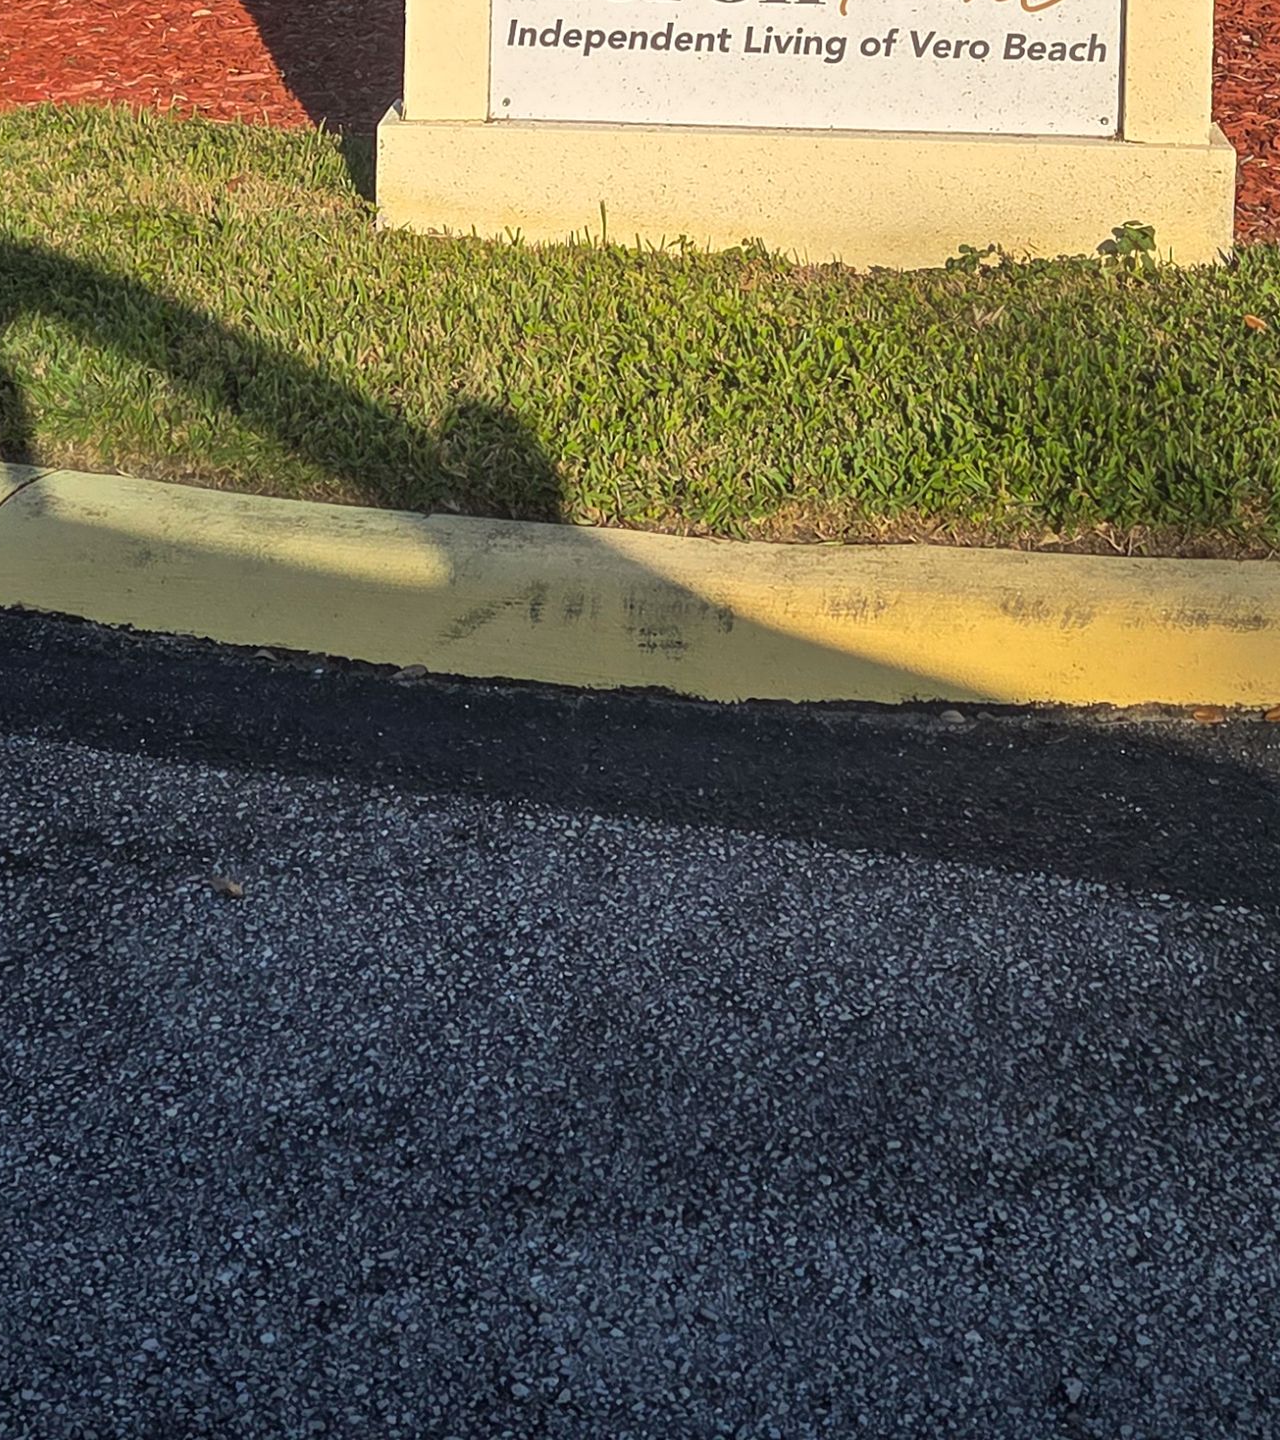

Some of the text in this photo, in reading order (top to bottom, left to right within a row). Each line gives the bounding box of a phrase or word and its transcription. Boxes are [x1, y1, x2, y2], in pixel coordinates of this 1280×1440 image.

[507, 19, 1108, 63] Independent Living of Vero Beach
